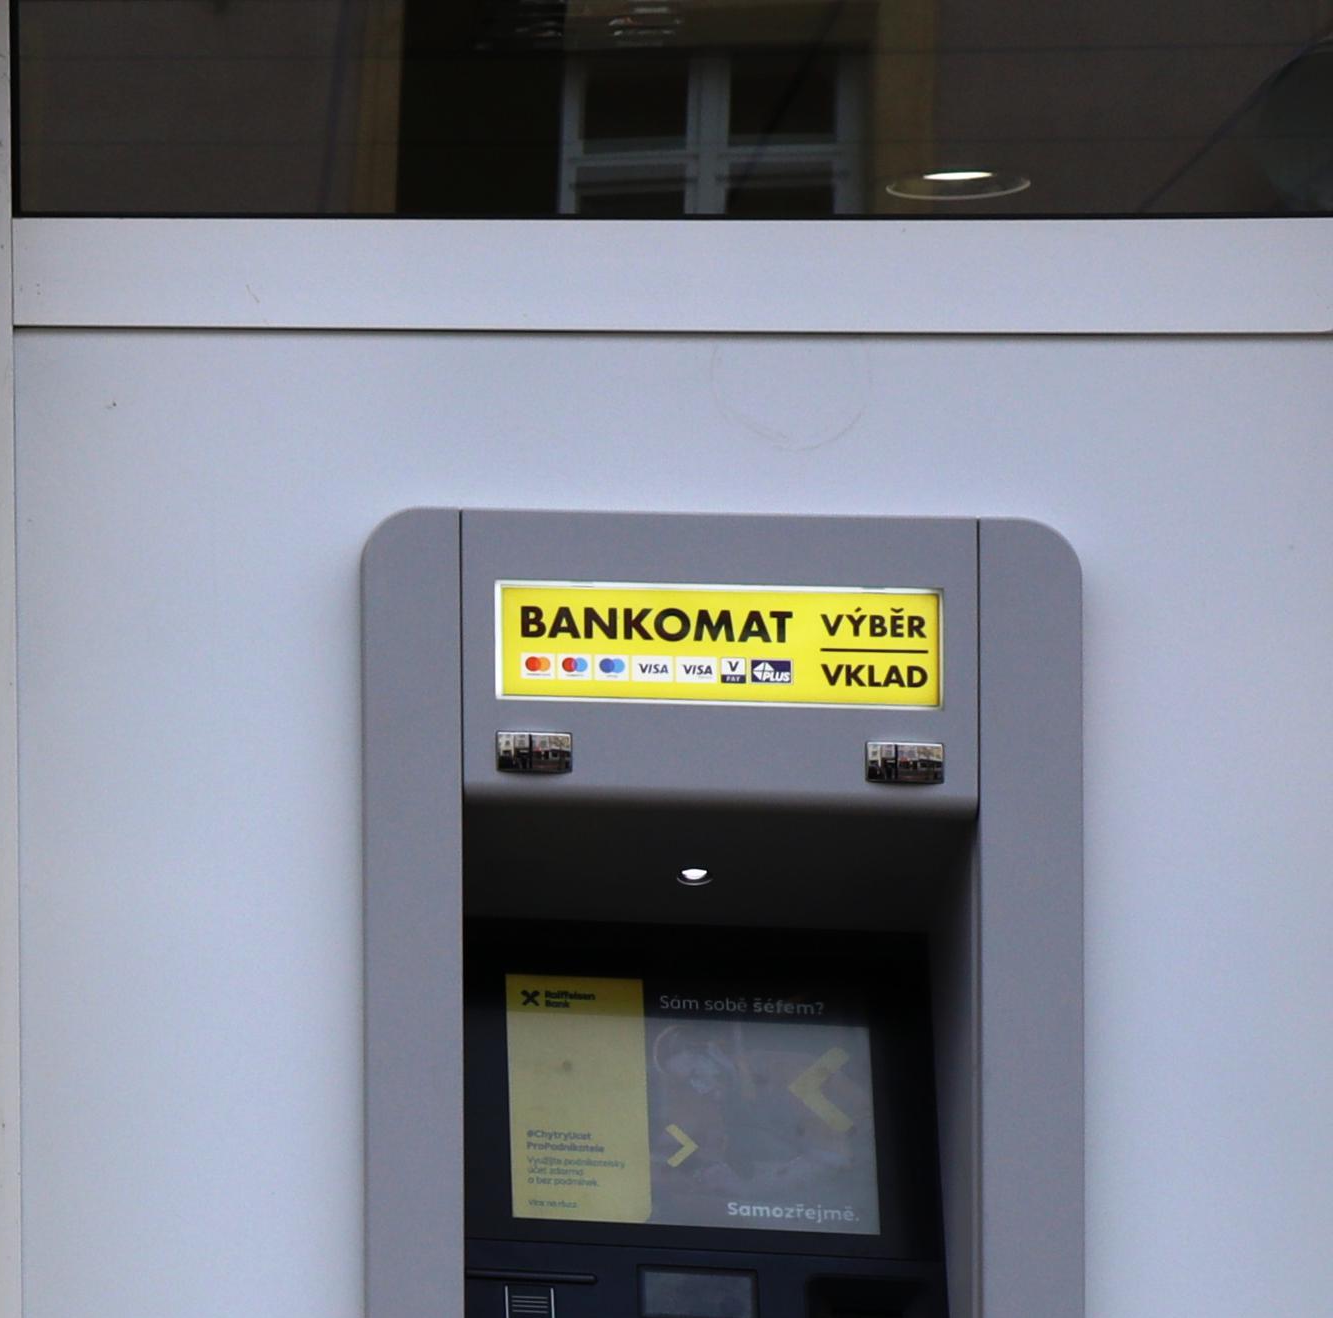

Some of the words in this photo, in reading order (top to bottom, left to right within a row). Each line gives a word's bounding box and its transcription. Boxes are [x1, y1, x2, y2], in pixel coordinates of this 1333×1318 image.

[520, 605, 794, 644] BANKOMAT
[820, 607, 928, 639] VÝBĚR
[638, 663, 669, 675] VISA
[682, 665, 713, 676] VISA
[763, 671, 791, 683] PLUS
[820, 663, 929, 689] VKLAD
[726, 1202, 861, 1223] Samozřejmě.
